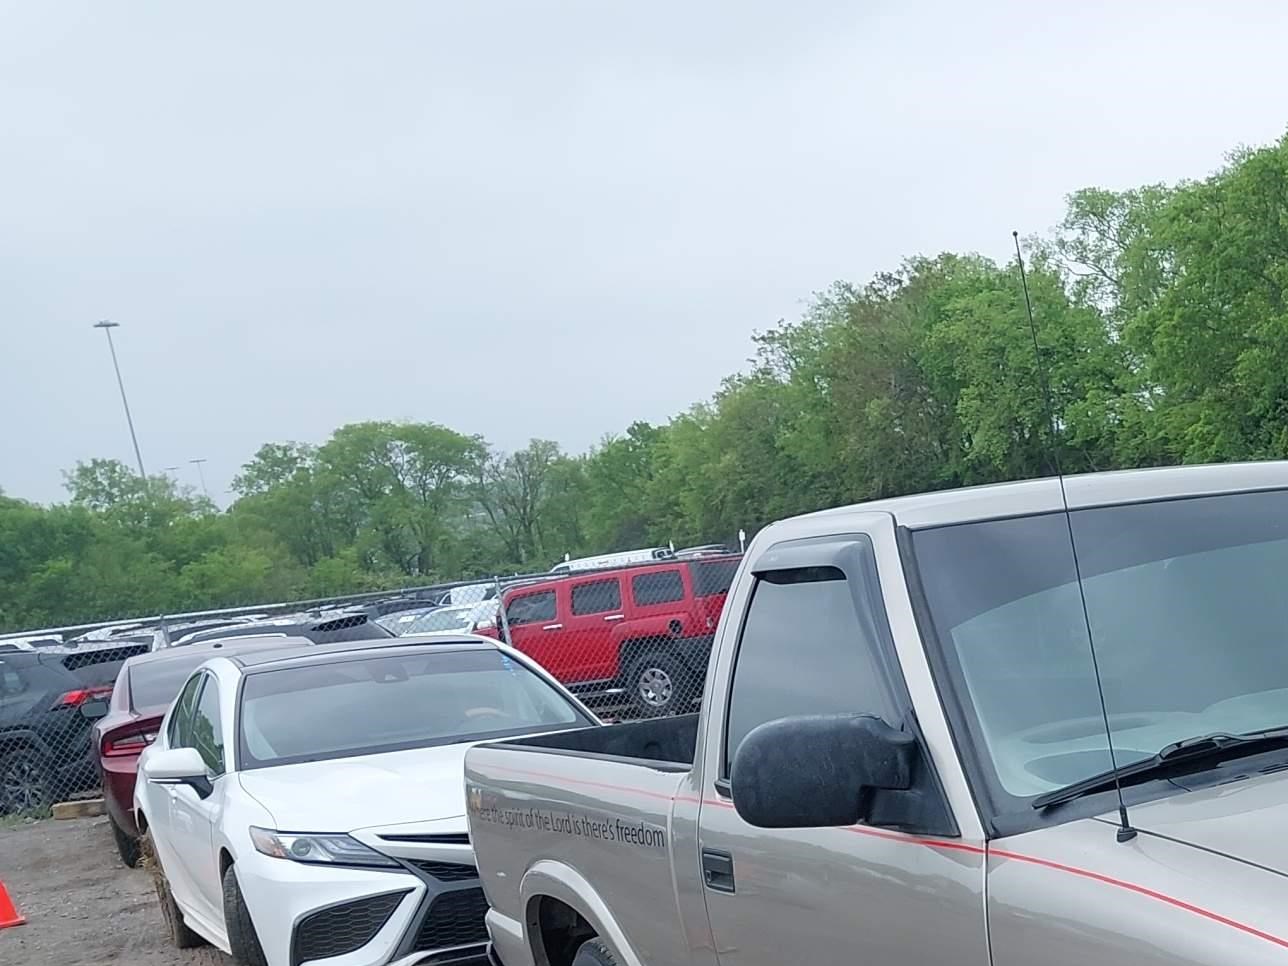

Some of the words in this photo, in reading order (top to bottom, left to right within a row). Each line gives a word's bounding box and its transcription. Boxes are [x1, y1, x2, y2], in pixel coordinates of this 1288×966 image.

[505, 807, 525, 830] spirit
[525, 808, 534, 828] of
[534, 809, 551, 831] the
[551, 811, 572, 834] Lord
[572, 815, 581, 835] is
[582, 816, 615, 841] there's
[616, 818, 665, 848] freedom
